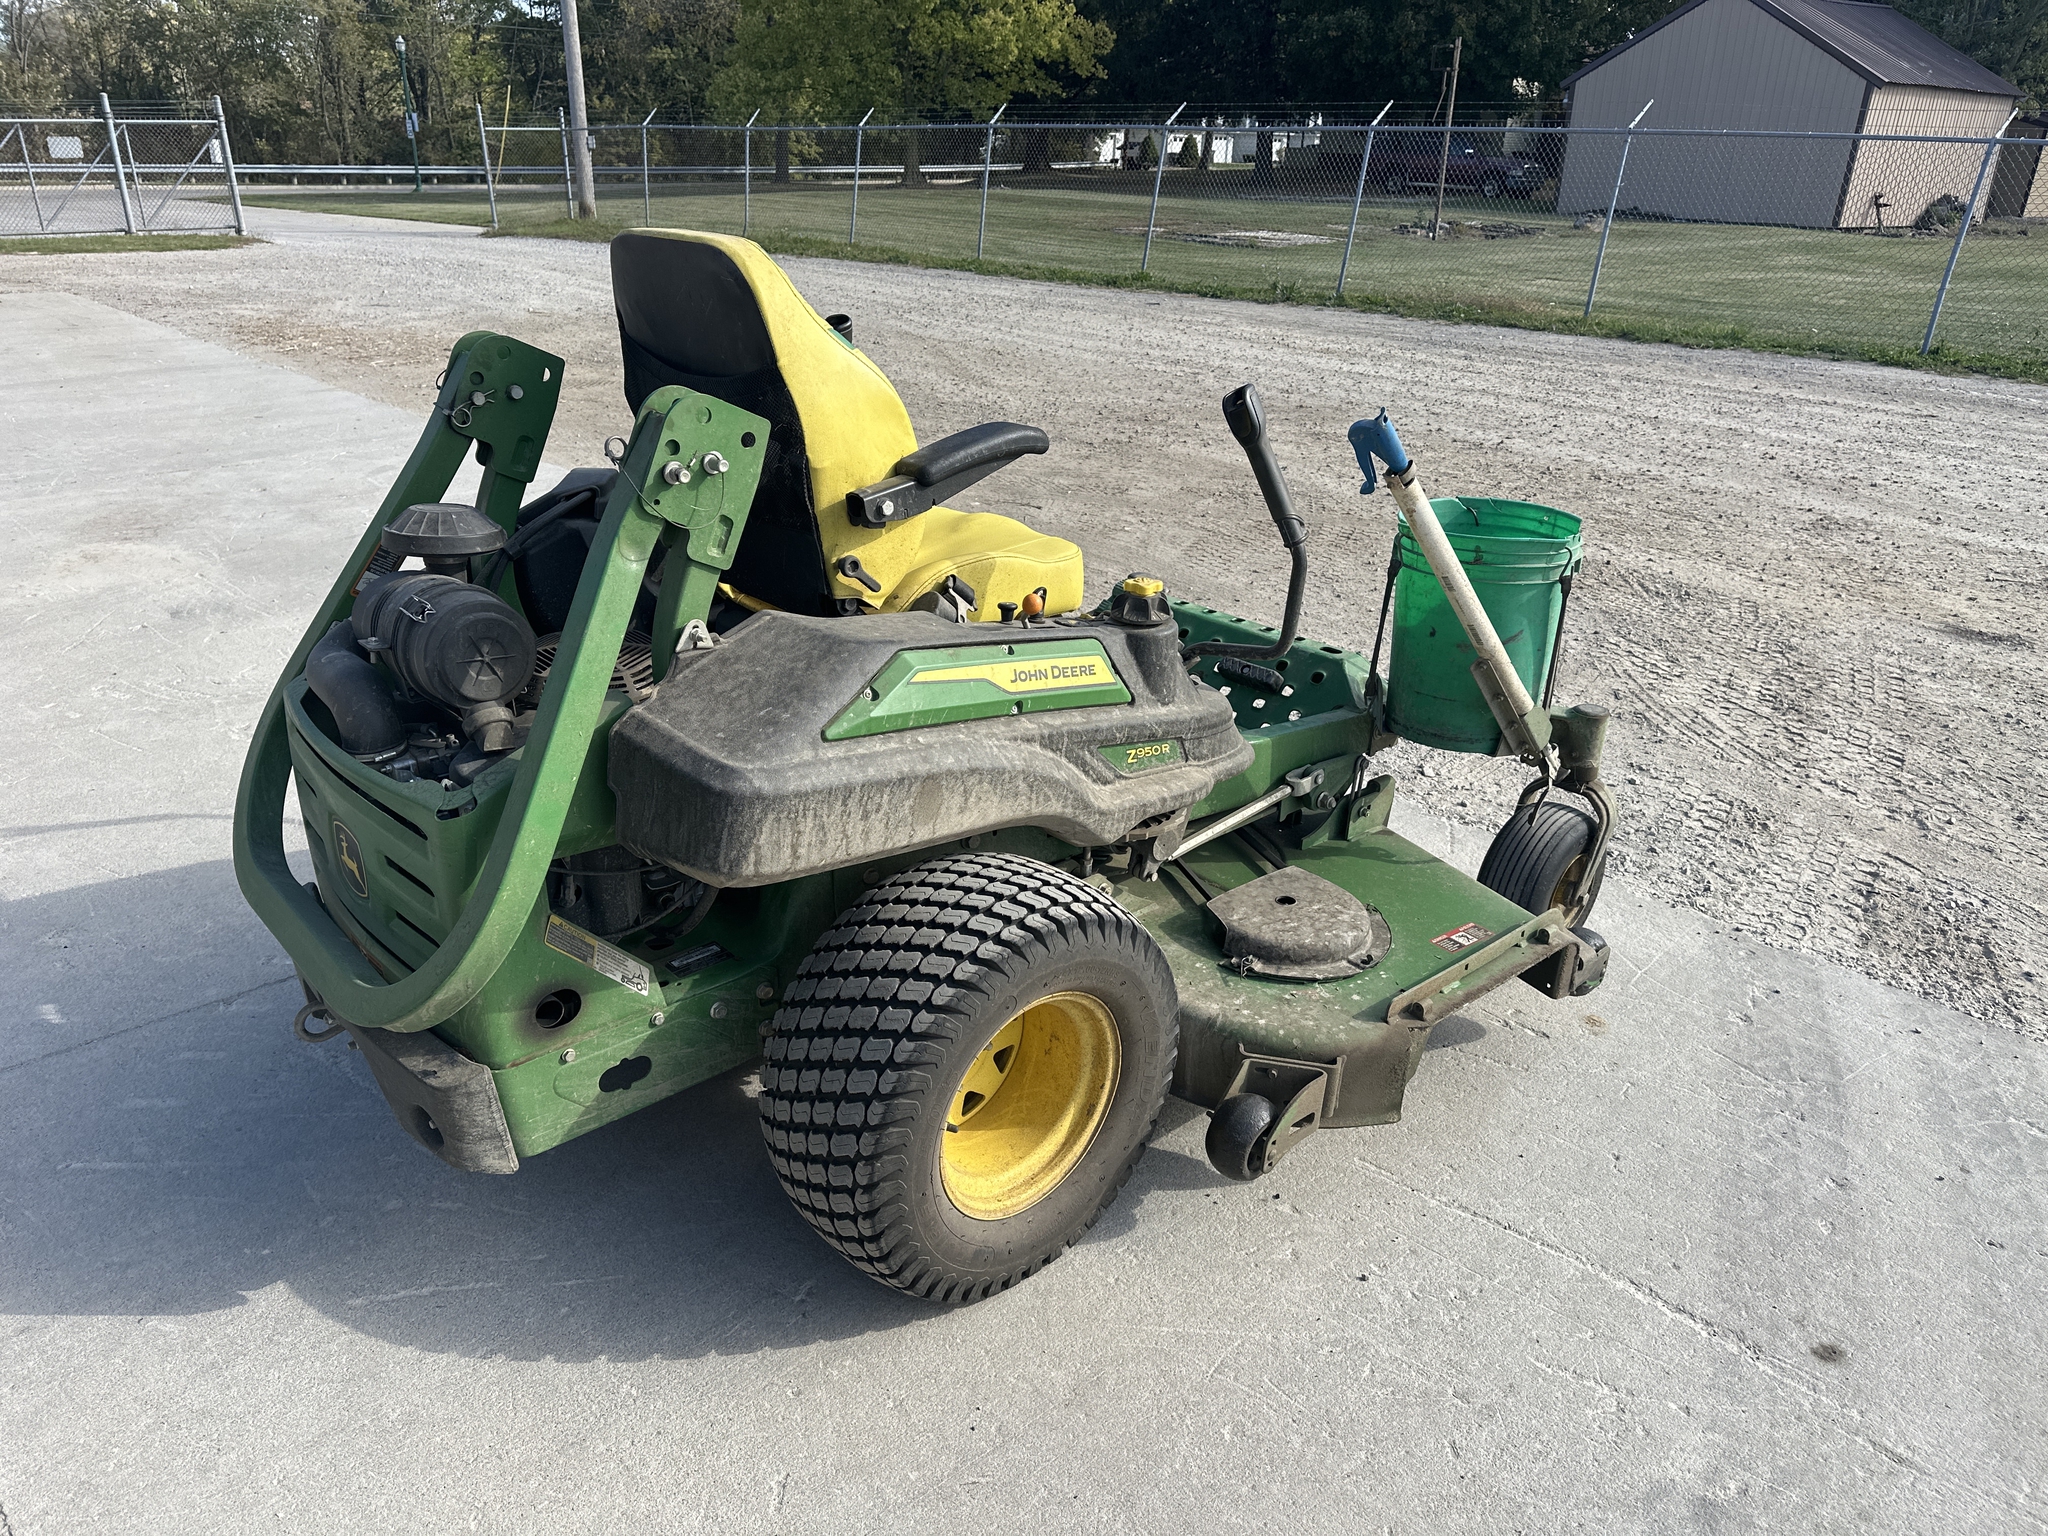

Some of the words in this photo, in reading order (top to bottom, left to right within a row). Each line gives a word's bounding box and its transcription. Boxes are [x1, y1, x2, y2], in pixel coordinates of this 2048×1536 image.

[1010, 668, 1048, 684] JOHN
[1051, 663, 1097, 680] DEERE
[1126, 743, 1170, 764] Z950R
[563, 924, 586, 941] CAUTION
[1127, 1009, 1161, 1126] KENDA
